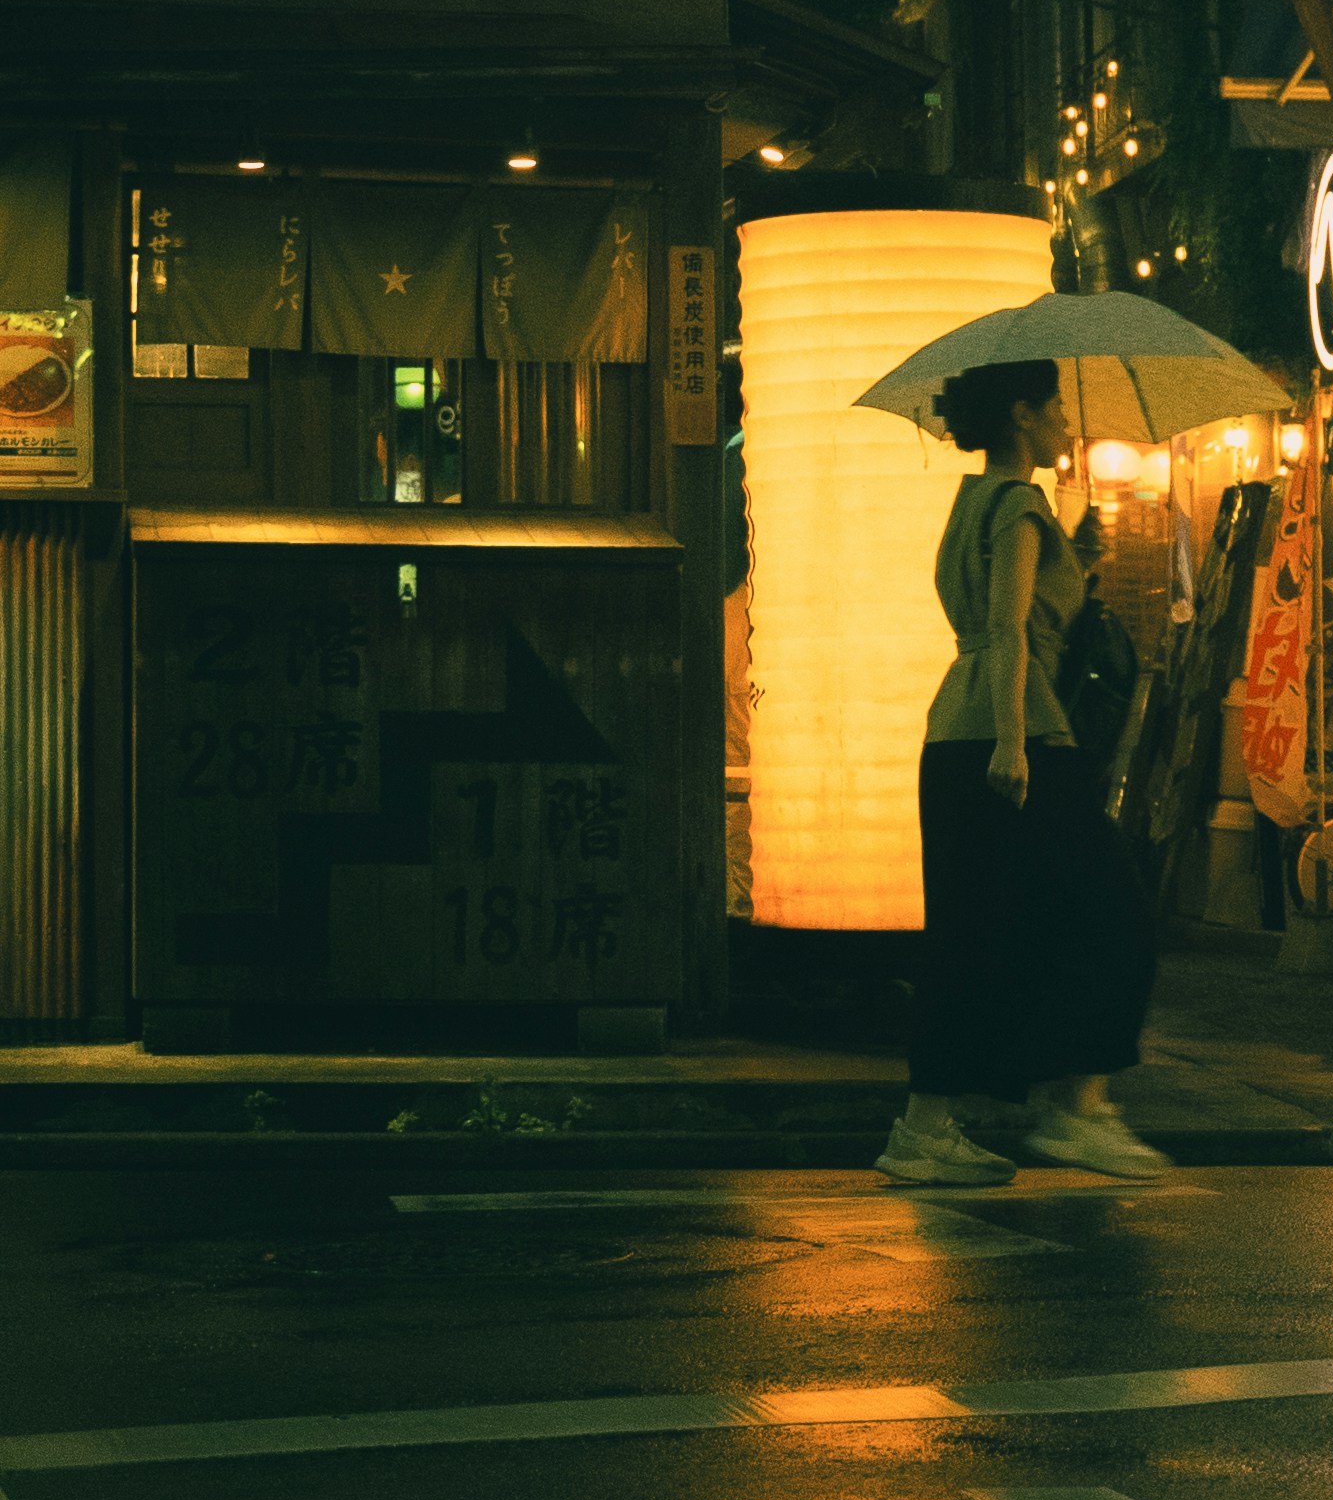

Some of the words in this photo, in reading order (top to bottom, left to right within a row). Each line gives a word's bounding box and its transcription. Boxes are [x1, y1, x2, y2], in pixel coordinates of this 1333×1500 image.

[682, 252, 705, 395] 備長炭使用店
